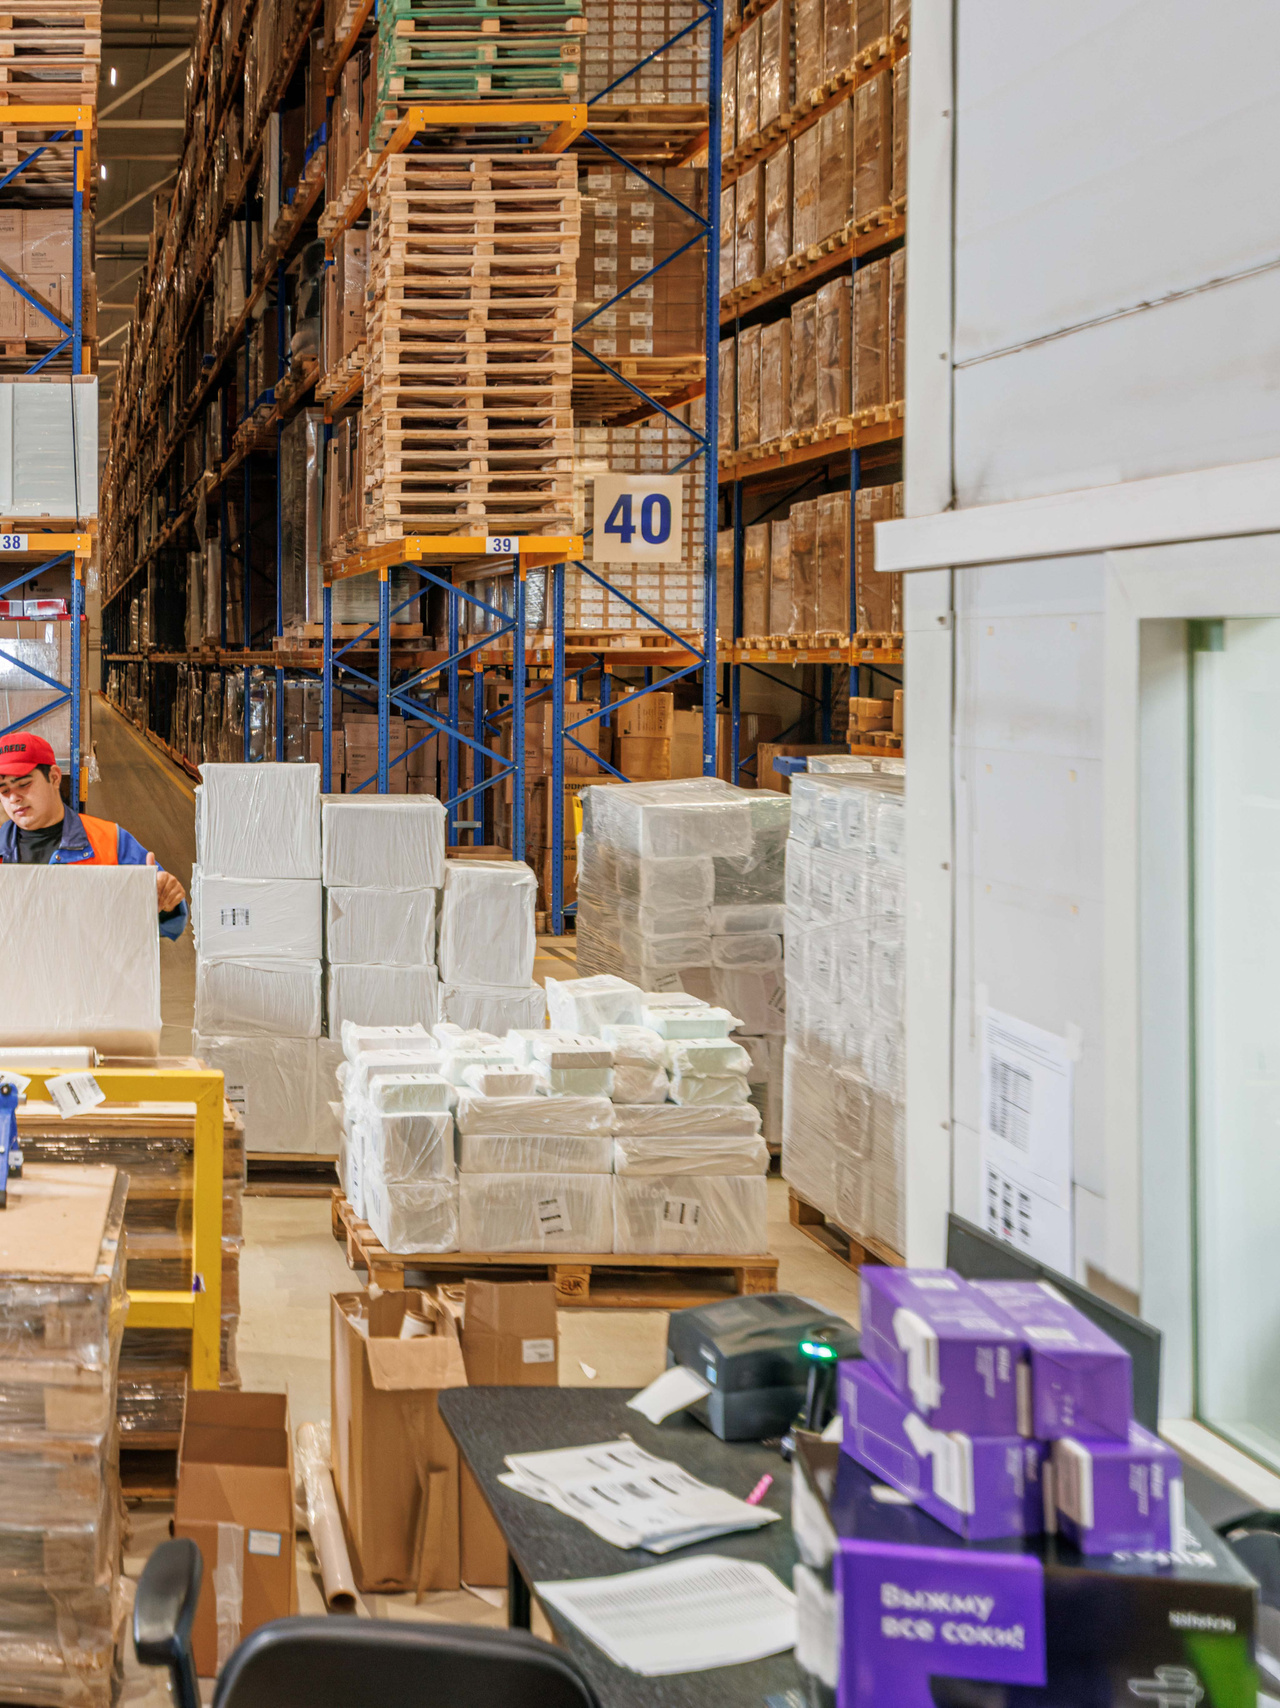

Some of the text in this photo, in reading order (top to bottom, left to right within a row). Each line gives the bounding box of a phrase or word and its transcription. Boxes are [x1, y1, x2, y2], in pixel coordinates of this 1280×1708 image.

[604, 493, 672, 544] 40
[2, 535, 21, 550] 38
[493, 538, 511, 552] 39
[880, 1582, 995, 1622] Выжму
[881, 1616, 1025, 1651] все соки!
